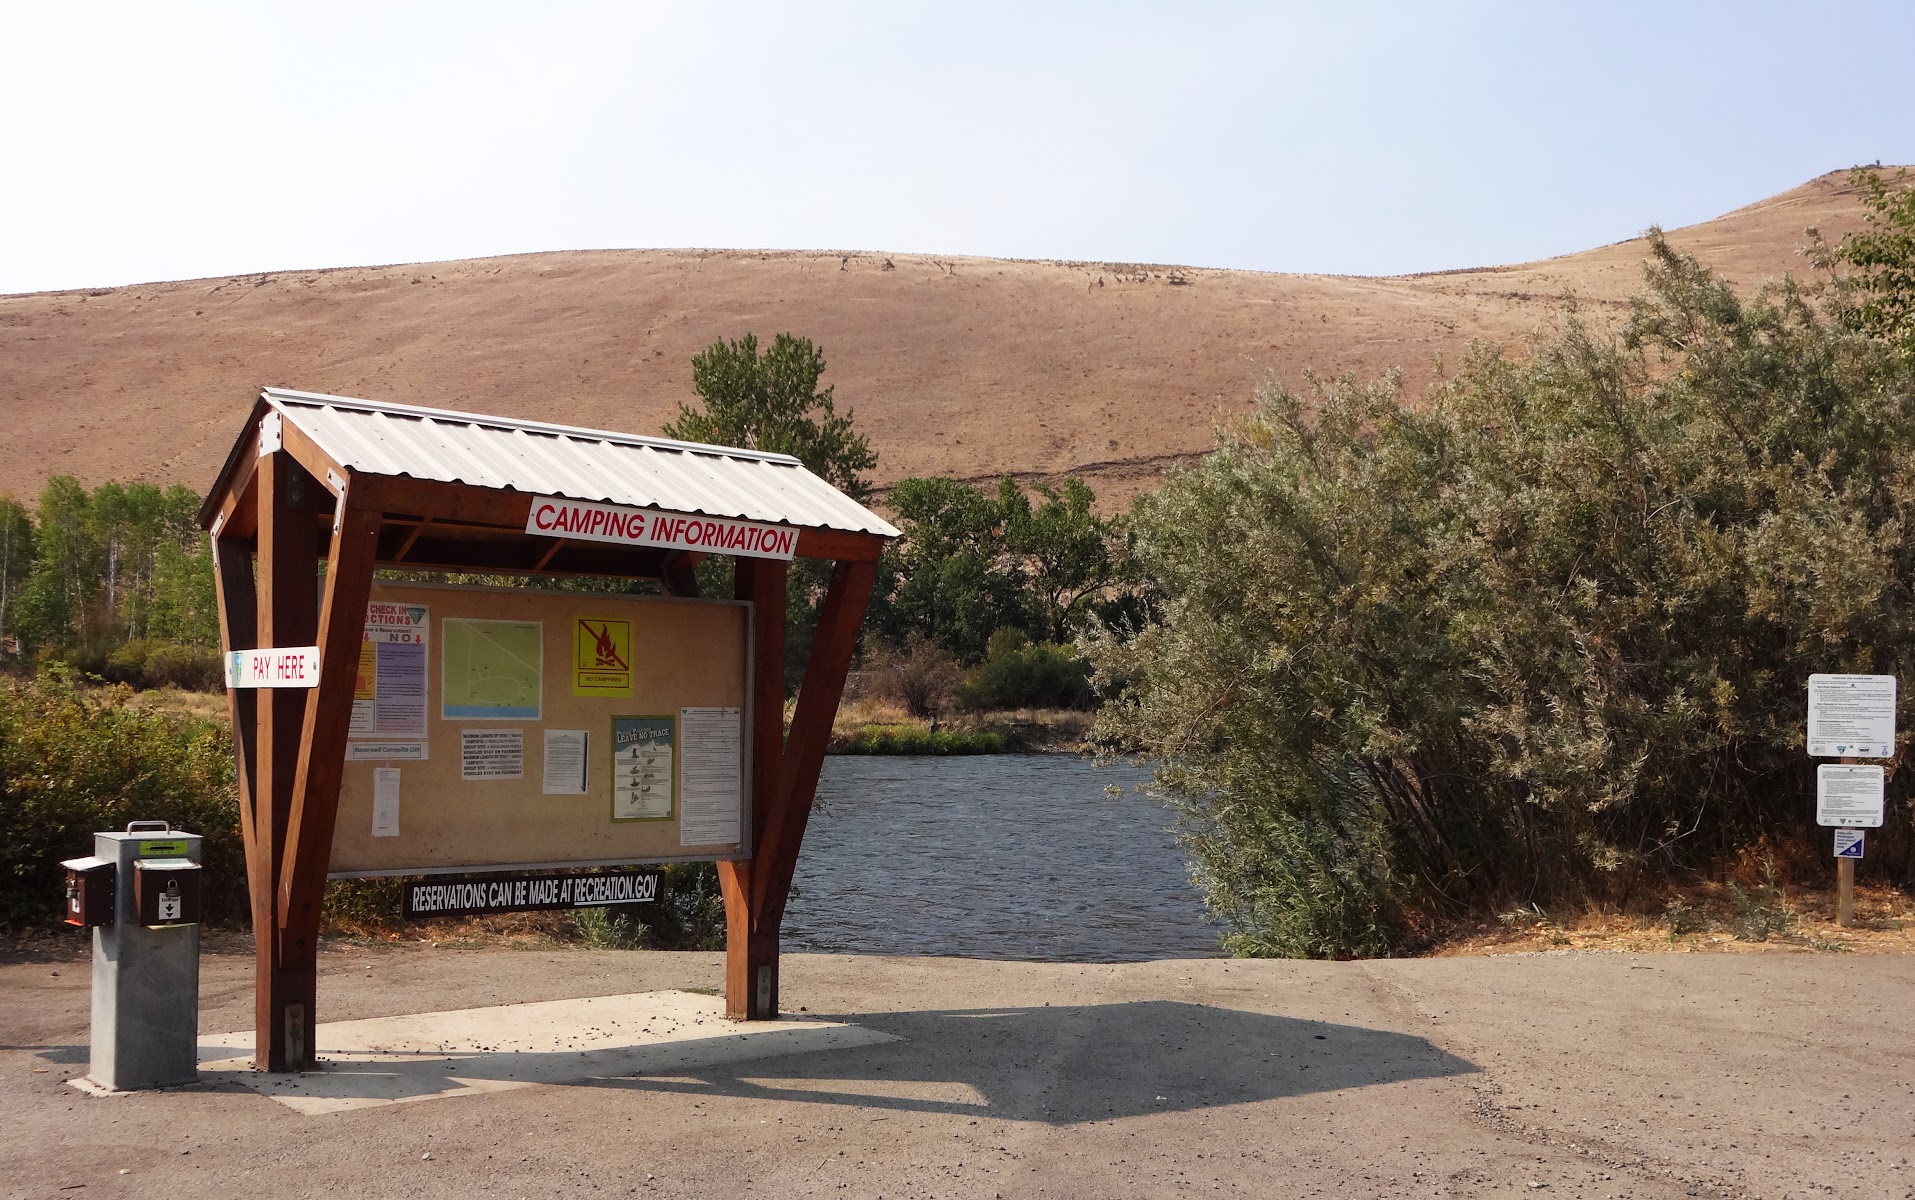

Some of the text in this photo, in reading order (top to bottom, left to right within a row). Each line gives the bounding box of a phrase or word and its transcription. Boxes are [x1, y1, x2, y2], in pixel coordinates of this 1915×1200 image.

[535, 504, 794, 555] CAMPING INFORMATION
[370, 605, 396, 615] CHECK
[389, 634, 412, 642] NO
[253, 655, 305, 680] PAY HERE
[617, 733, 638, 744] LEAVE
[639, 731, 649, 740] NO
[649, 728, 671, 739] TRACE
[382, 746, 409, 754] Campsite
[412, 874, 659, 912] RESERVATIONS CAN BE MADE AT RECREATION.GOV
